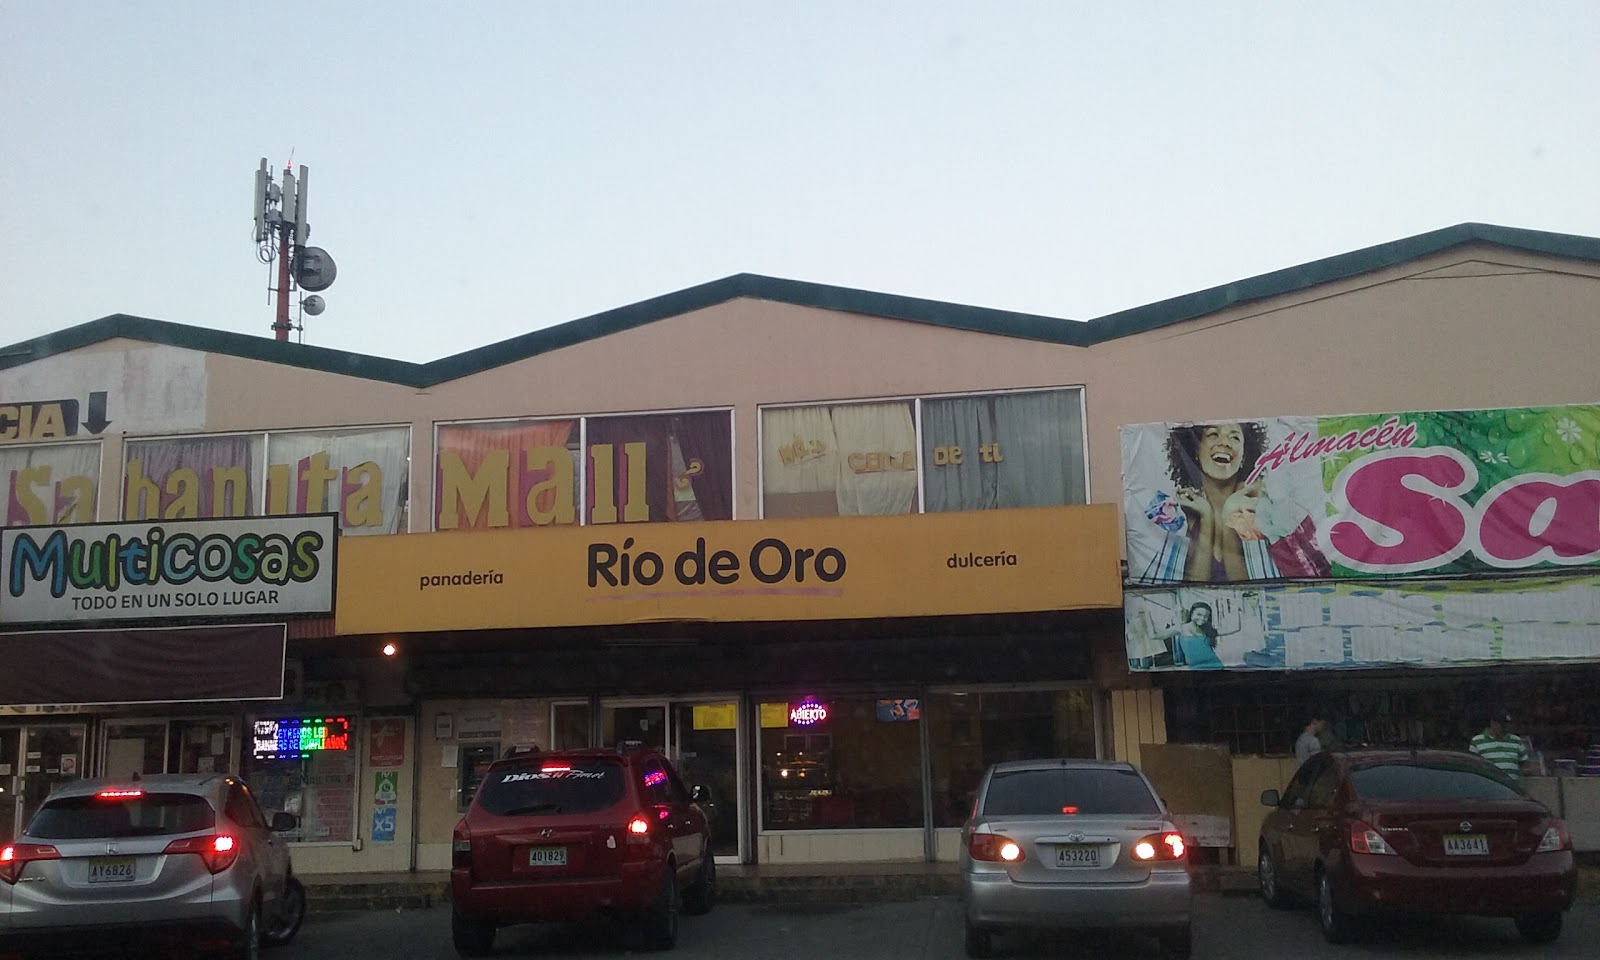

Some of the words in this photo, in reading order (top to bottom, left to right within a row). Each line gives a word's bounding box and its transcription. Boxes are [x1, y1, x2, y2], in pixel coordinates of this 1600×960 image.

[1246, 417, 1418, 486] Almacén
[438, 441, 650, 530] Mall
[9, 527, 324, 599] Multicosas
[587, 537, 664, 588] Río
[674, 537, 740, 586] de
[749, 538, 847, 584] Oro
[946, 551, 1017, 570] dulcería
[419, 569, 504, 590] panadería
[72, 596, 117, 611] TODO
[121, 595, 142, 609] EN
[146, 594, 171, 609] UN
[175, 592, 219, 607] SOLO
[222, 590, 279, 606] LUGAR
[790, 708, 827, 721] ABIERTO
[313, 726, 328, 738] LED
[1447, 839, 1485, 850] AA3641
[532, 851, 564, 861] 401829
[1059, 850, 1097, 862] 453220
